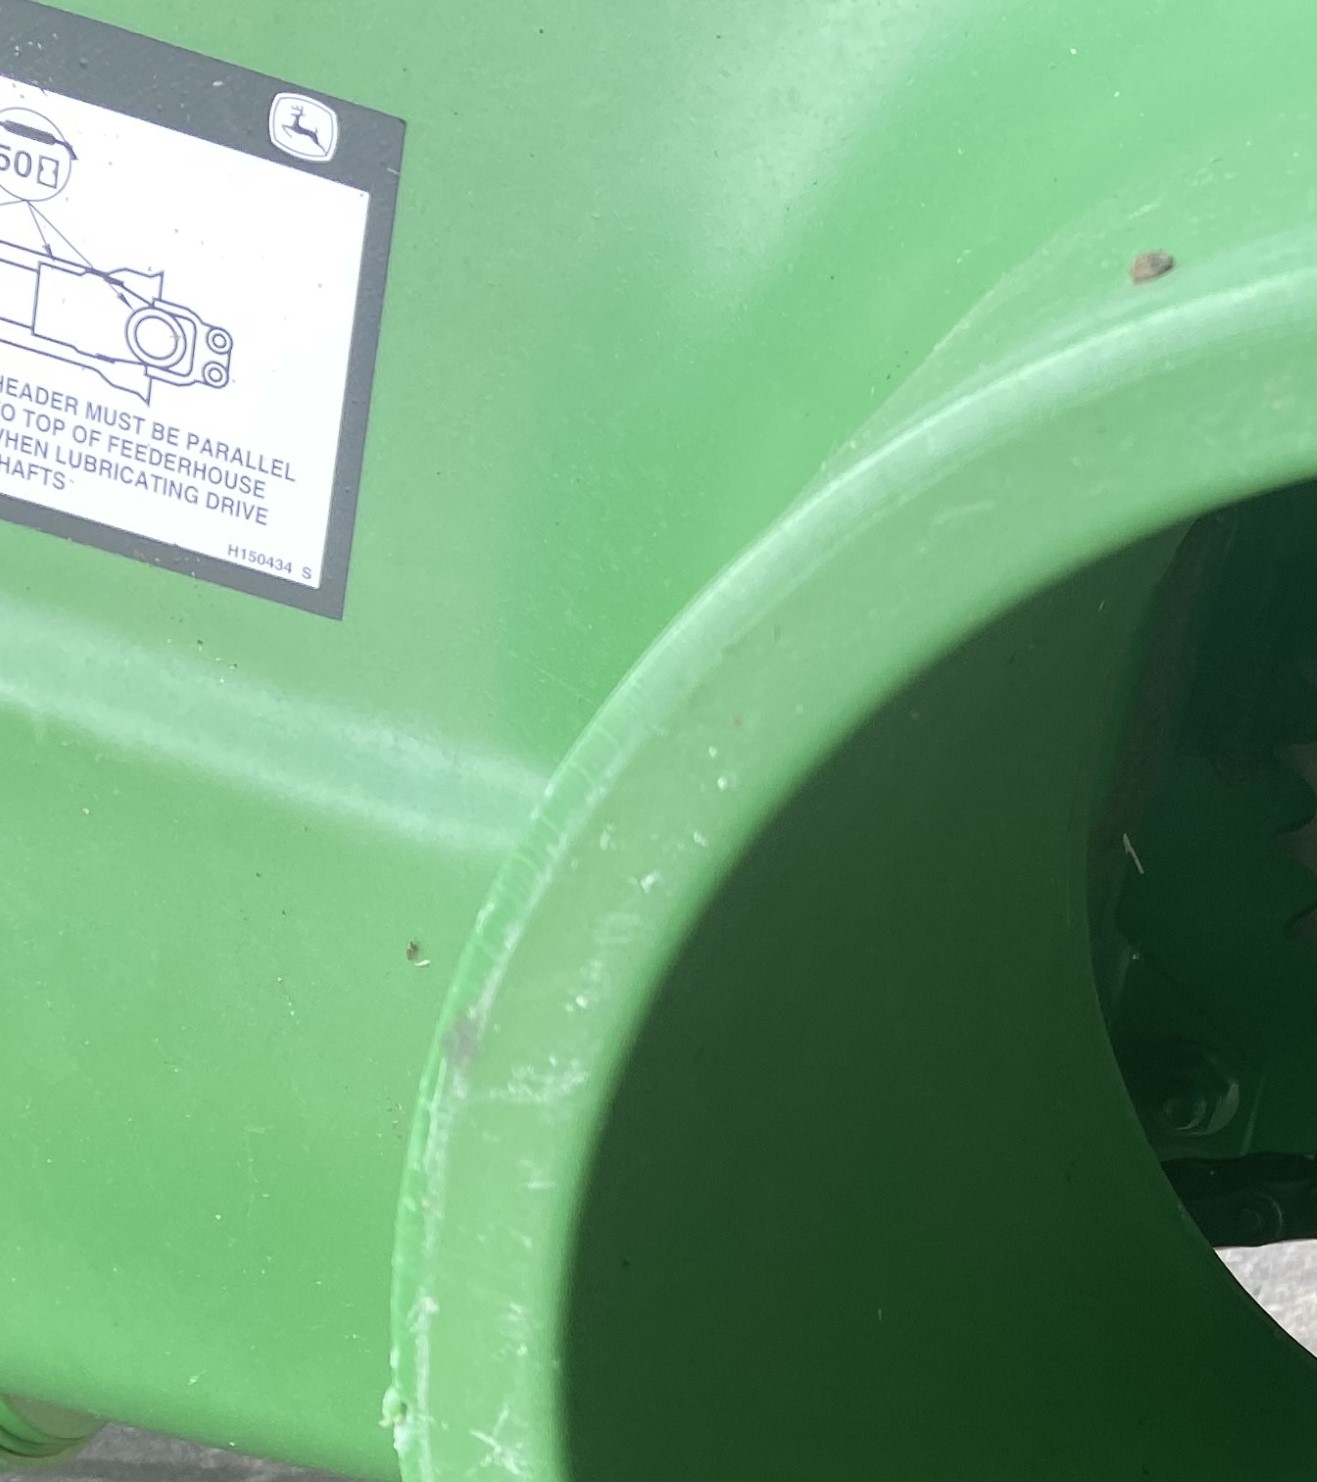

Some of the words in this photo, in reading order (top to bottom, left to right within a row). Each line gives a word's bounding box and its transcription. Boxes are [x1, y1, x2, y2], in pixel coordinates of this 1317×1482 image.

[0, 403, 16, 422] O
[23, 408, 66, 437] TOP
[72, 425, 102, 448] OF
[107, 435, 267, 500] FEEDERHOUSE
[0, 453, 66, 491] HAFTS
[0, 427, 49, 460] HEN
[55, 445, 200, 505] LUBRICATING
[205, 491, 270, 526] DRIVE
[85, 401, 146, 435] MUST
[151, 421, 181, 447] BE
[186, 433, 297, 483] PARALLEL
[227, 543, 292, 575] H150434
[301, 566, 312, 580] S
